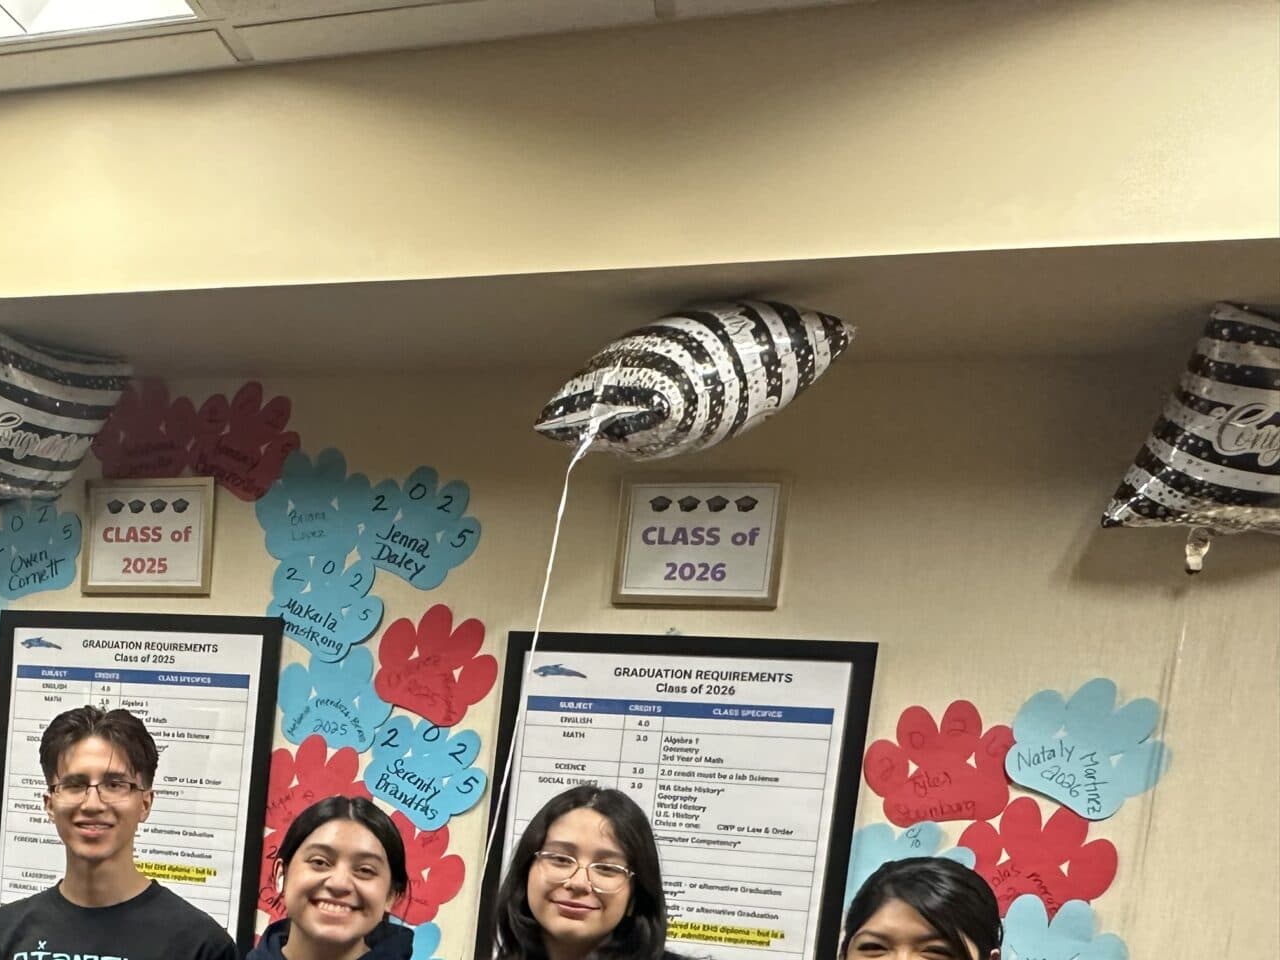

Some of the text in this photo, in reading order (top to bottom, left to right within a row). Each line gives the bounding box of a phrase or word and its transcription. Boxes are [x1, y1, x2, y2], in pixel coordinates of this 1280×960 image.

[102, 526, 192, 543] CLASS of
[375, 524, 430, 559] Jenna
[641, 526, 760, 546] CLASS of
[122, 557, 168, 574] 2025
[371, 541, 426, 582] Daley
[663, 562, 727, 582] 2026
[82, 639, 219, 654] GRADUATION REQUIREMENTS
[114, 653, 176, 664] Class of 2025
[614, 667, 793, 683] GRADUATION REQUIREMENTS
[656, 683, 736, 696] Class of 2026
[312, 718, 348, 736] 2025
[386, 758, 442, 801] Serenity
